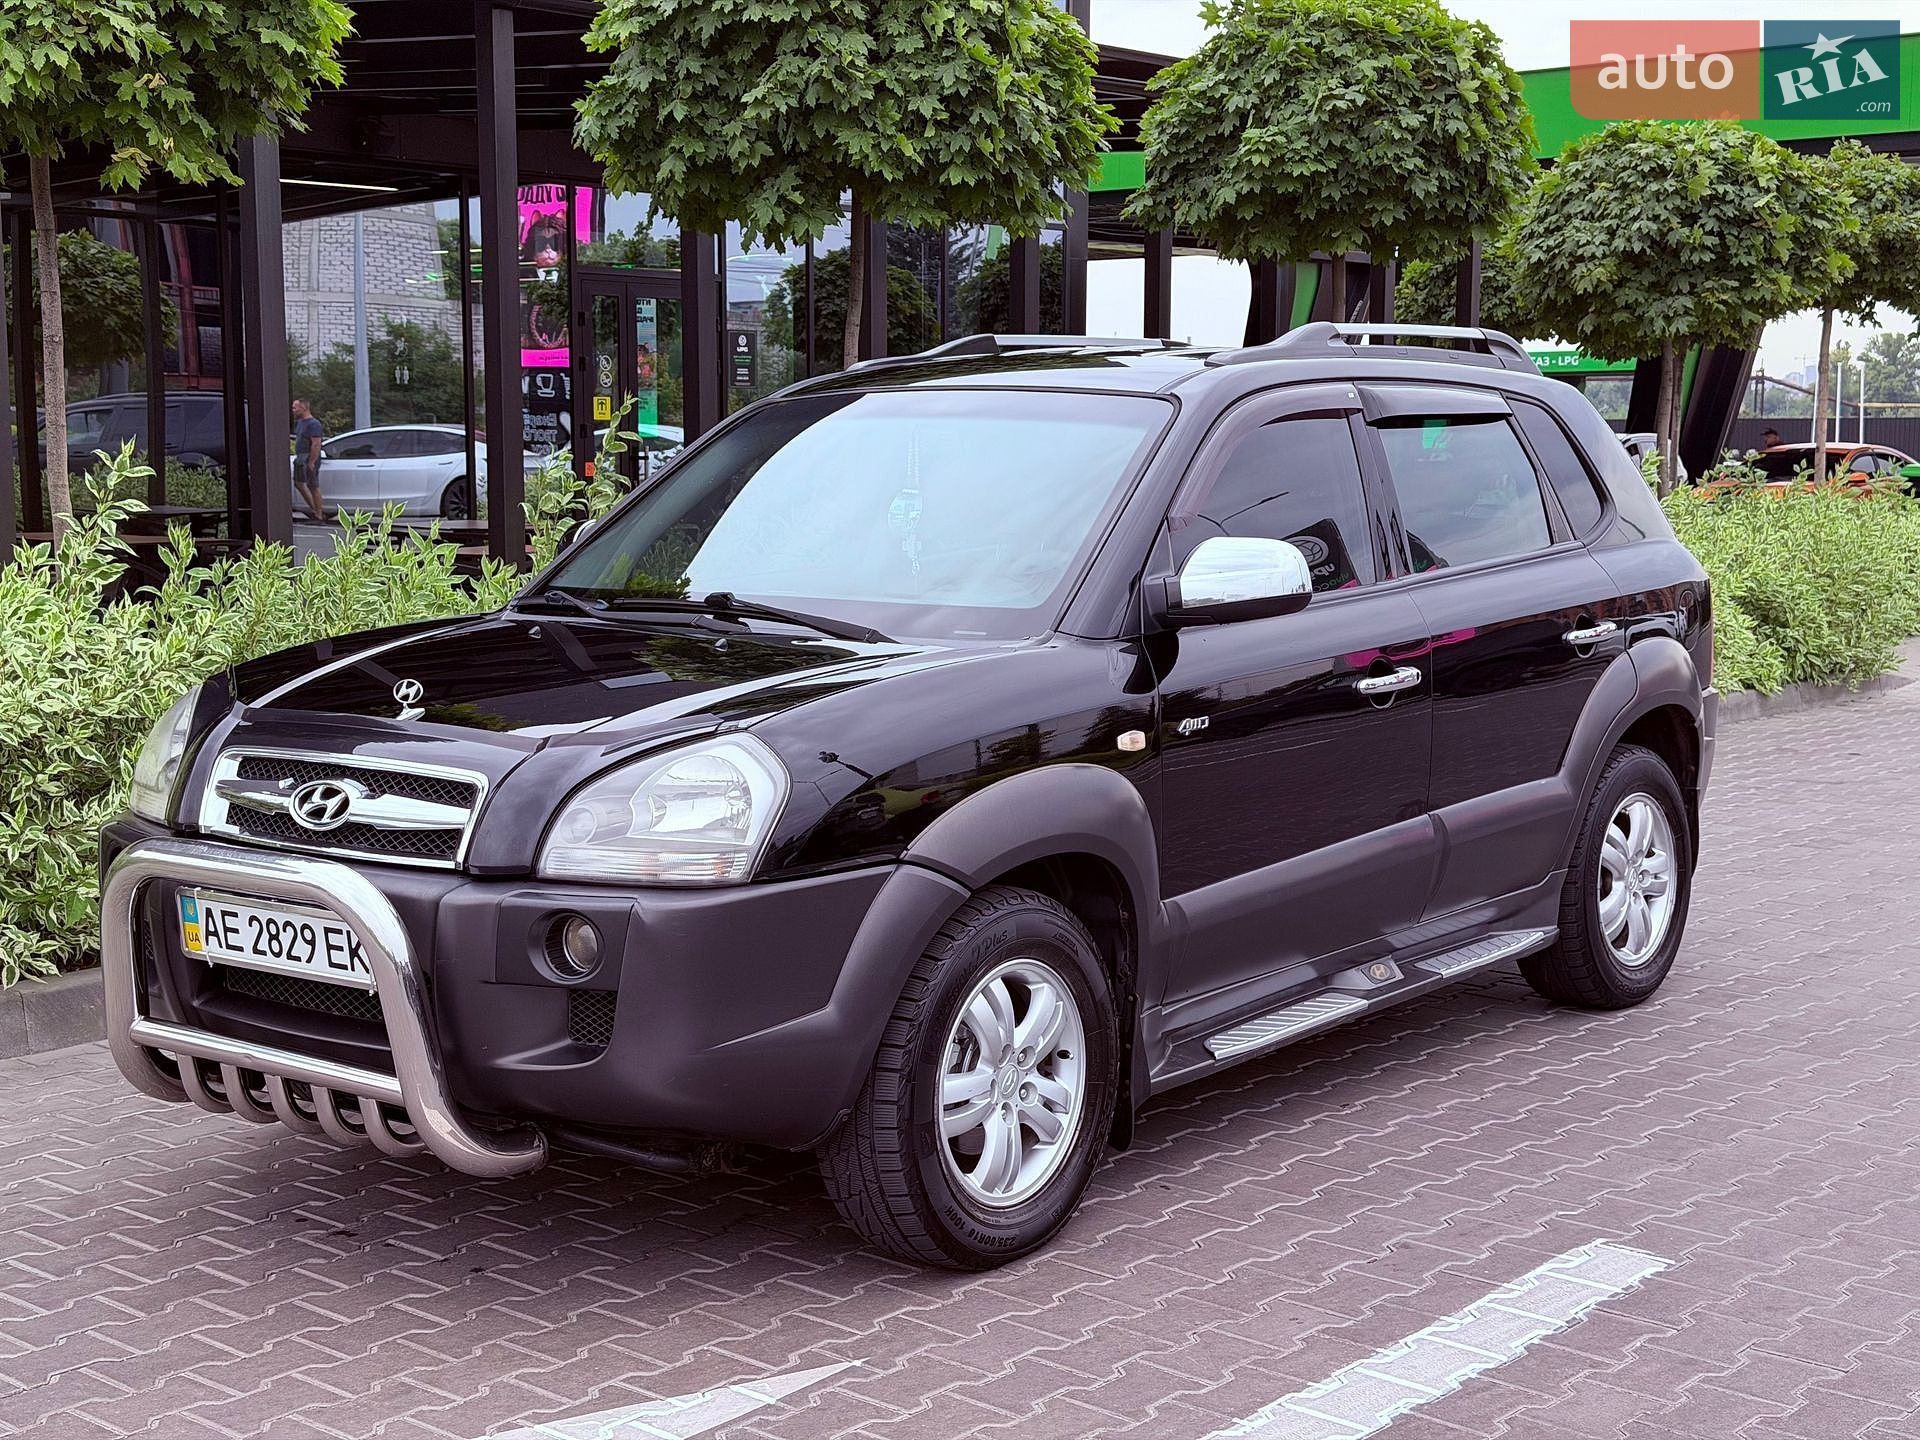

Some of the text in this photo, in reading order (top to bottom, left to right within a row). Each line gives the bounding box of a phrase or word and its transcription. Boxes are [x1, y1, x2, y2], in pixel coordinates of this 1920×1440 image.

[1558, 355, 1579, 366] LPG
[188, 931, 201, 944] UA
[205, 907, 371, 975] AE 2829 EK
[944, 1206, 967, 1230] 100H
